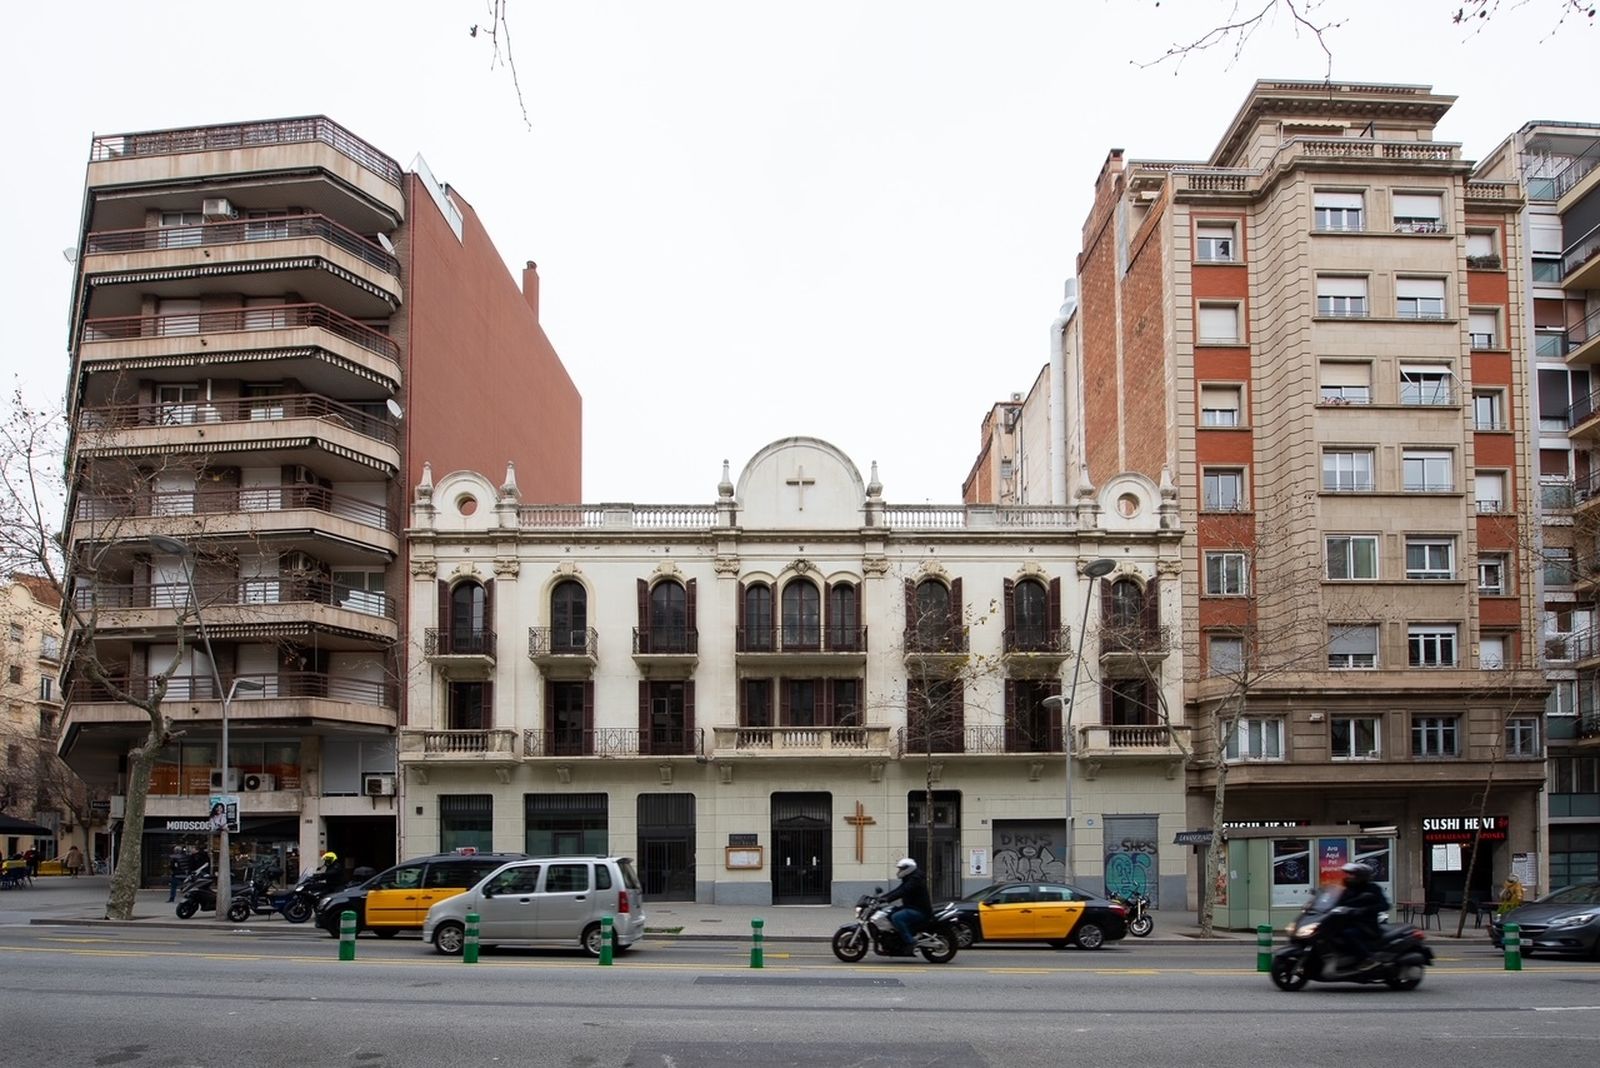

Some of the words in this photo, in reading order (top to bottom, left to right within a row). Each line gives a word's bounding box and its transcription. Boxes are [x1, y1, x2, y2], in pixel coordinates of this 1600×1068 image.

[1423, 818, 1460, 830] SUSHI
[1464, 818, 1479, 829] HE
[1482, 817, 1494, 829] VI
